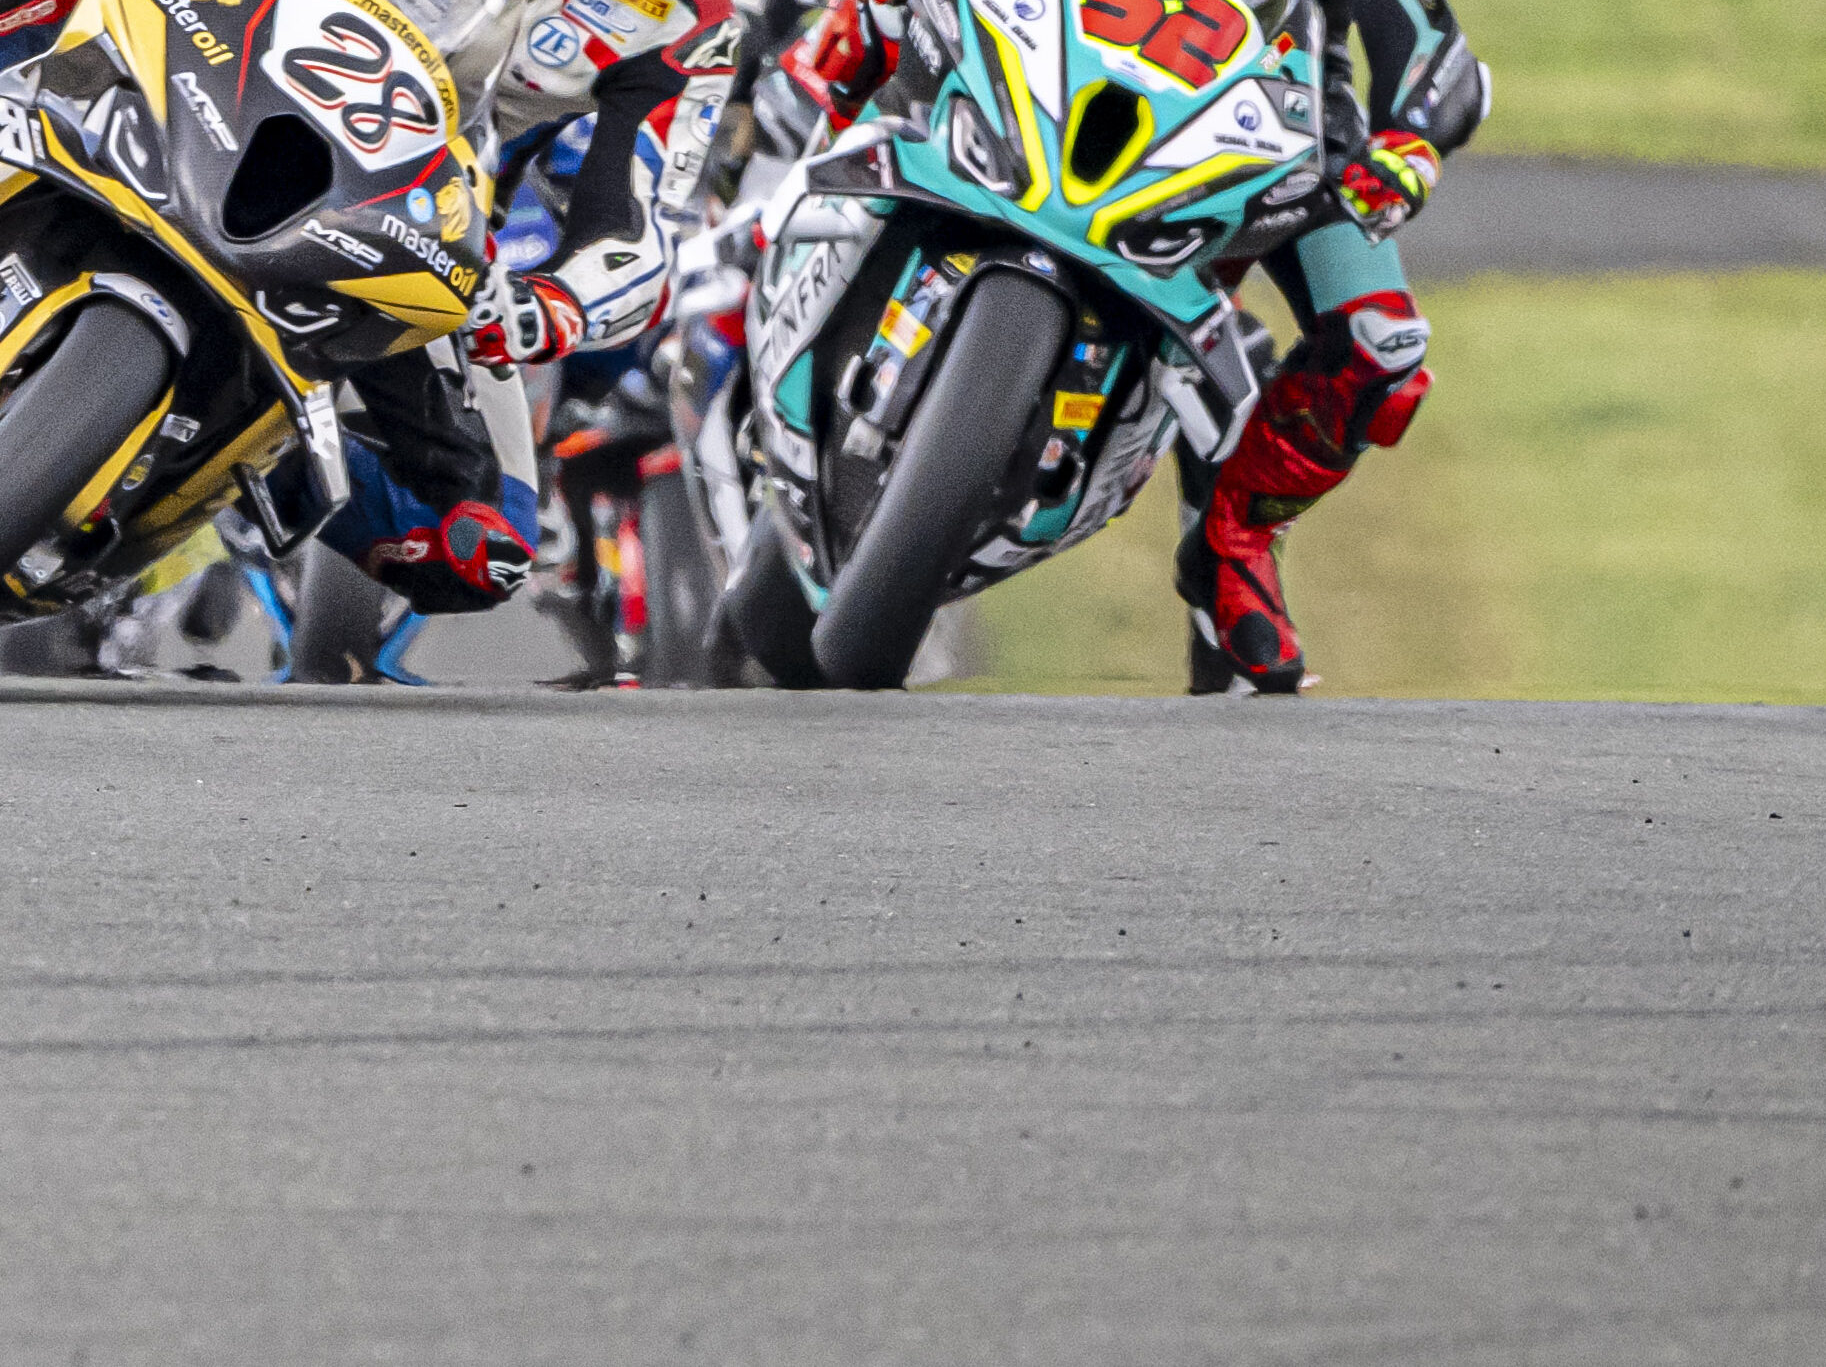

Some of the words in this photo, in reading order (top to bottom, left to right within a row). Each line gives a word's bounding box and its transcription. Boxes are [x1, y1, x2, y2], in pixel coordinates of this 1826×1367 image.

[170, 71, 239, 152] MRP
[282, 11, 438, 154] 28
[301, 218, 385, 267] MRP
[380, 213, 480, 297] masteroil
